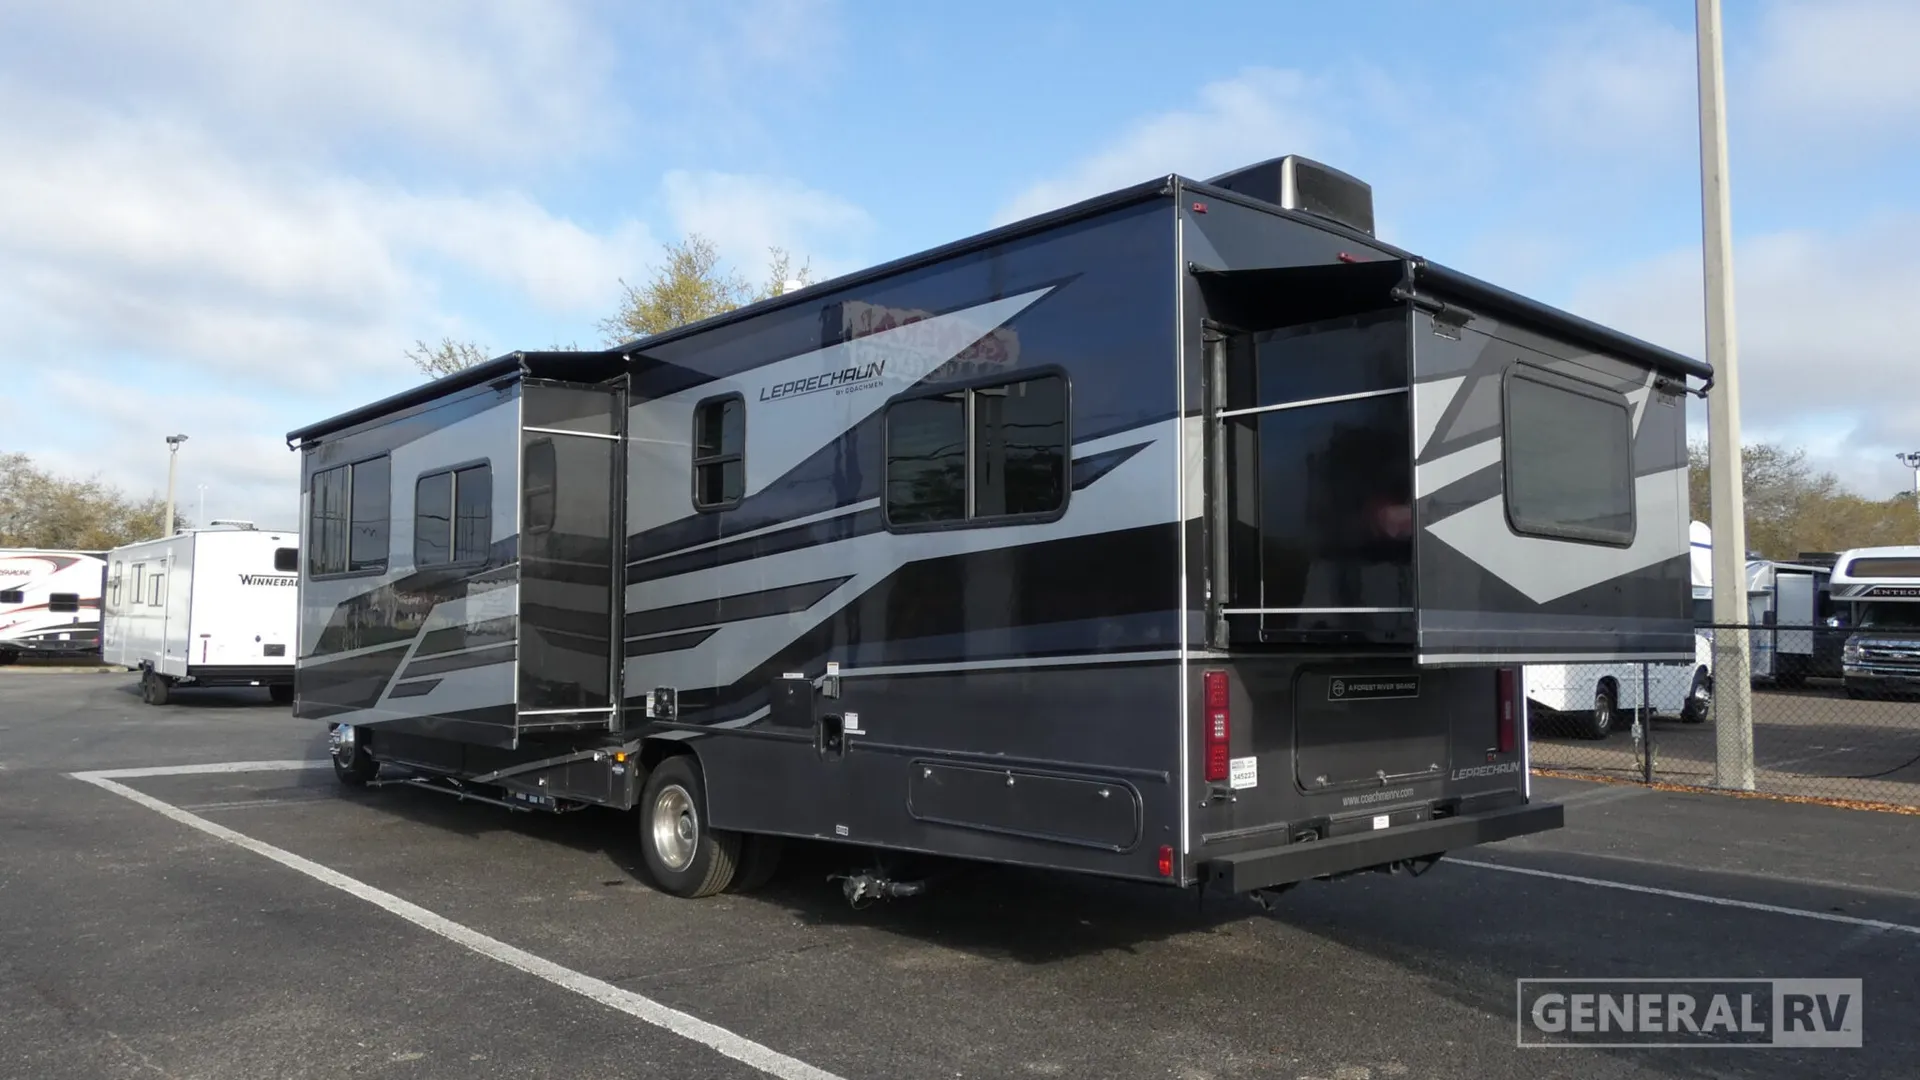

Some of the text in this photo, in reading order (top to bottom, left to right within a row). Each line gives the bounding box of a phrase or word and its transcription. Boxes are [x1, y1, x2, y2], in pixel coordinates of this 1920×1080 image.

[760, 360, 885, 402] LEPRECHAUN
[836, 380, 884, 396] BY COACHMEN
[1451, 760, 1520, 781] LEPRECHAUN
[1342, 788, 1414, 806] www.coachmenrv.com
